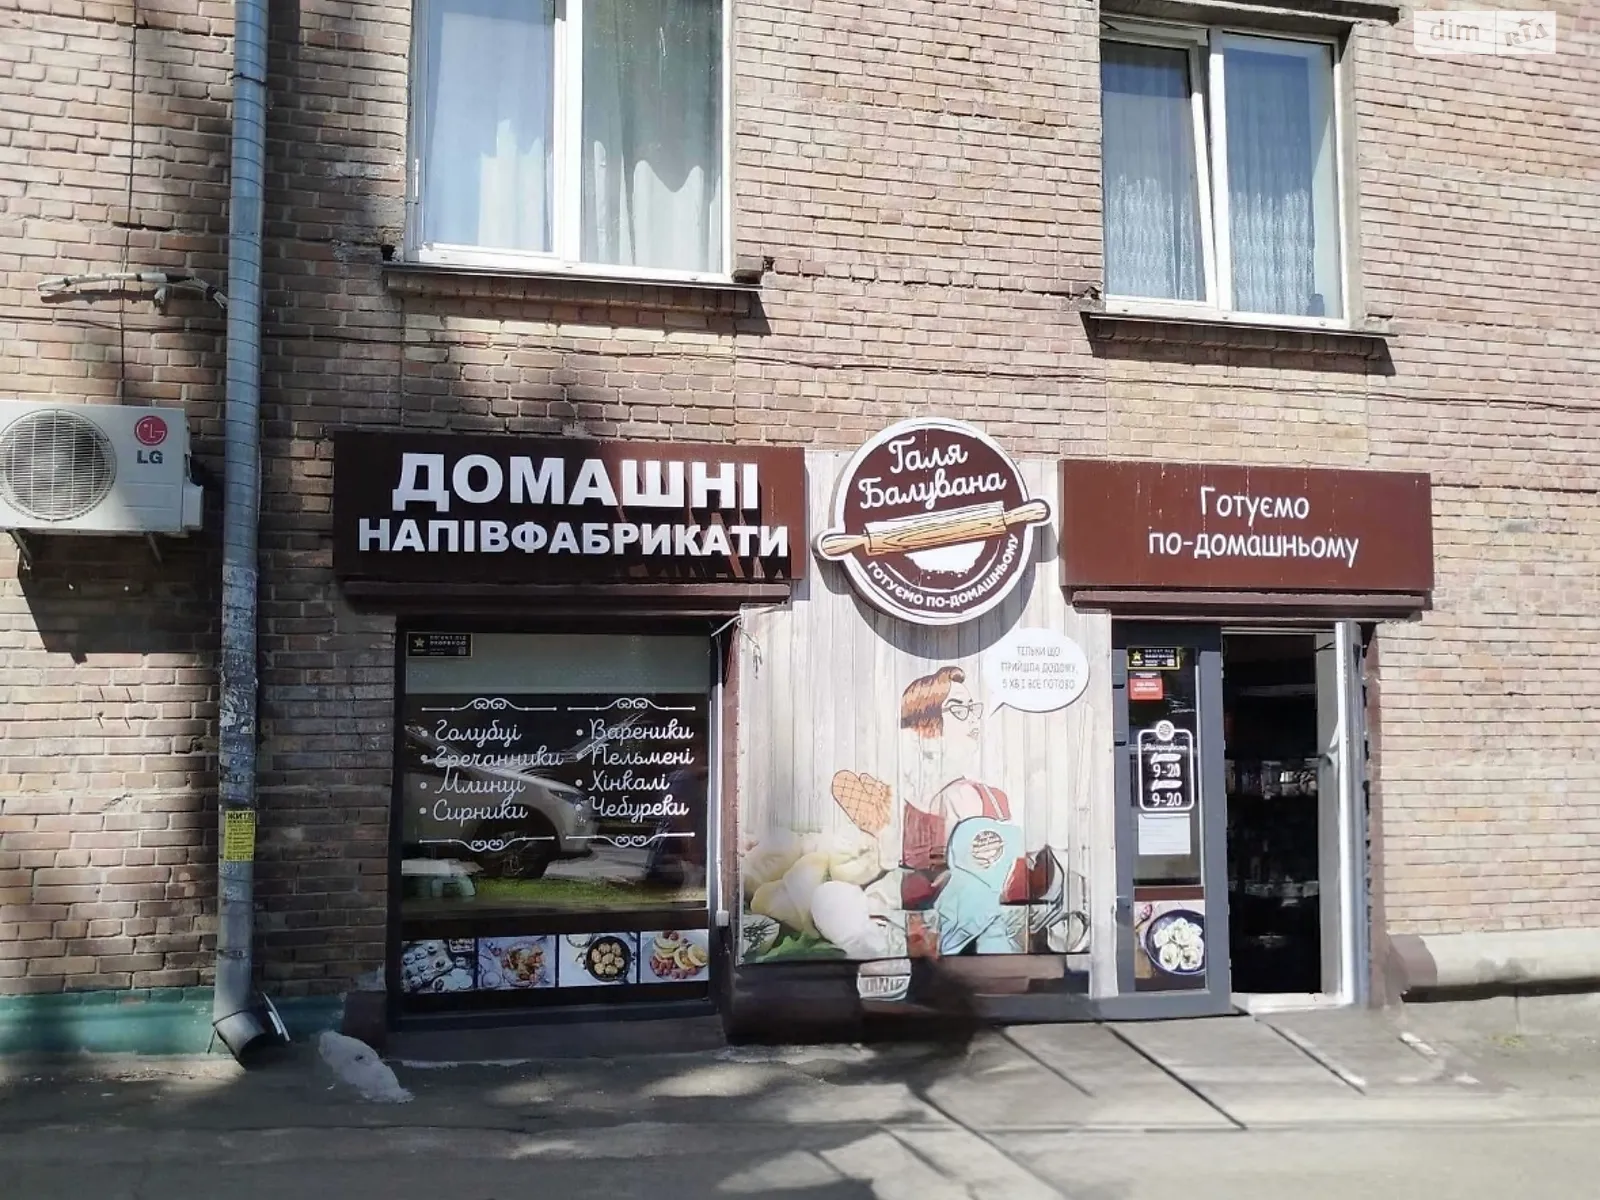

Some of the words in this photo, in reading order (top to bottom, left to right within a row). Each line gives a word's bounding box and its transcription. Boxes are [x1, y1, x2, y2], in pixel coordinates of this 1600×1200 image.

[136, 449, 164, 465] LG
[888, 435, 968, 474] Галя
[392, 452, 758, 512] ДОМАШНІ
[858, 468, 1007, 510] Балувана
[1200, 486, 1310, 527] Готуємо
[358, 518, 788, 557] НАПІВФАБРИКАТИ
[1149, 532, 1359, 568] по-домашньому
[867, 561, 924, 606] ГОТУЄМО
[926, 533, 1019, 608] ПО-ДОМАШНЬОМУ
[435, 719, 522, 748] Голубці
[589, 718, 694, 746] Вареники
[434, 745, 564, 769] Гречанники
[588, 743, 695, 766] Пельмені
[588, 769, 670, 793] Хінкалі
[433, 797, 529, 828] Сирники
[588, 794, 690, 824] Чебуреки
[1151, 792, 1182, 807] 9-20
